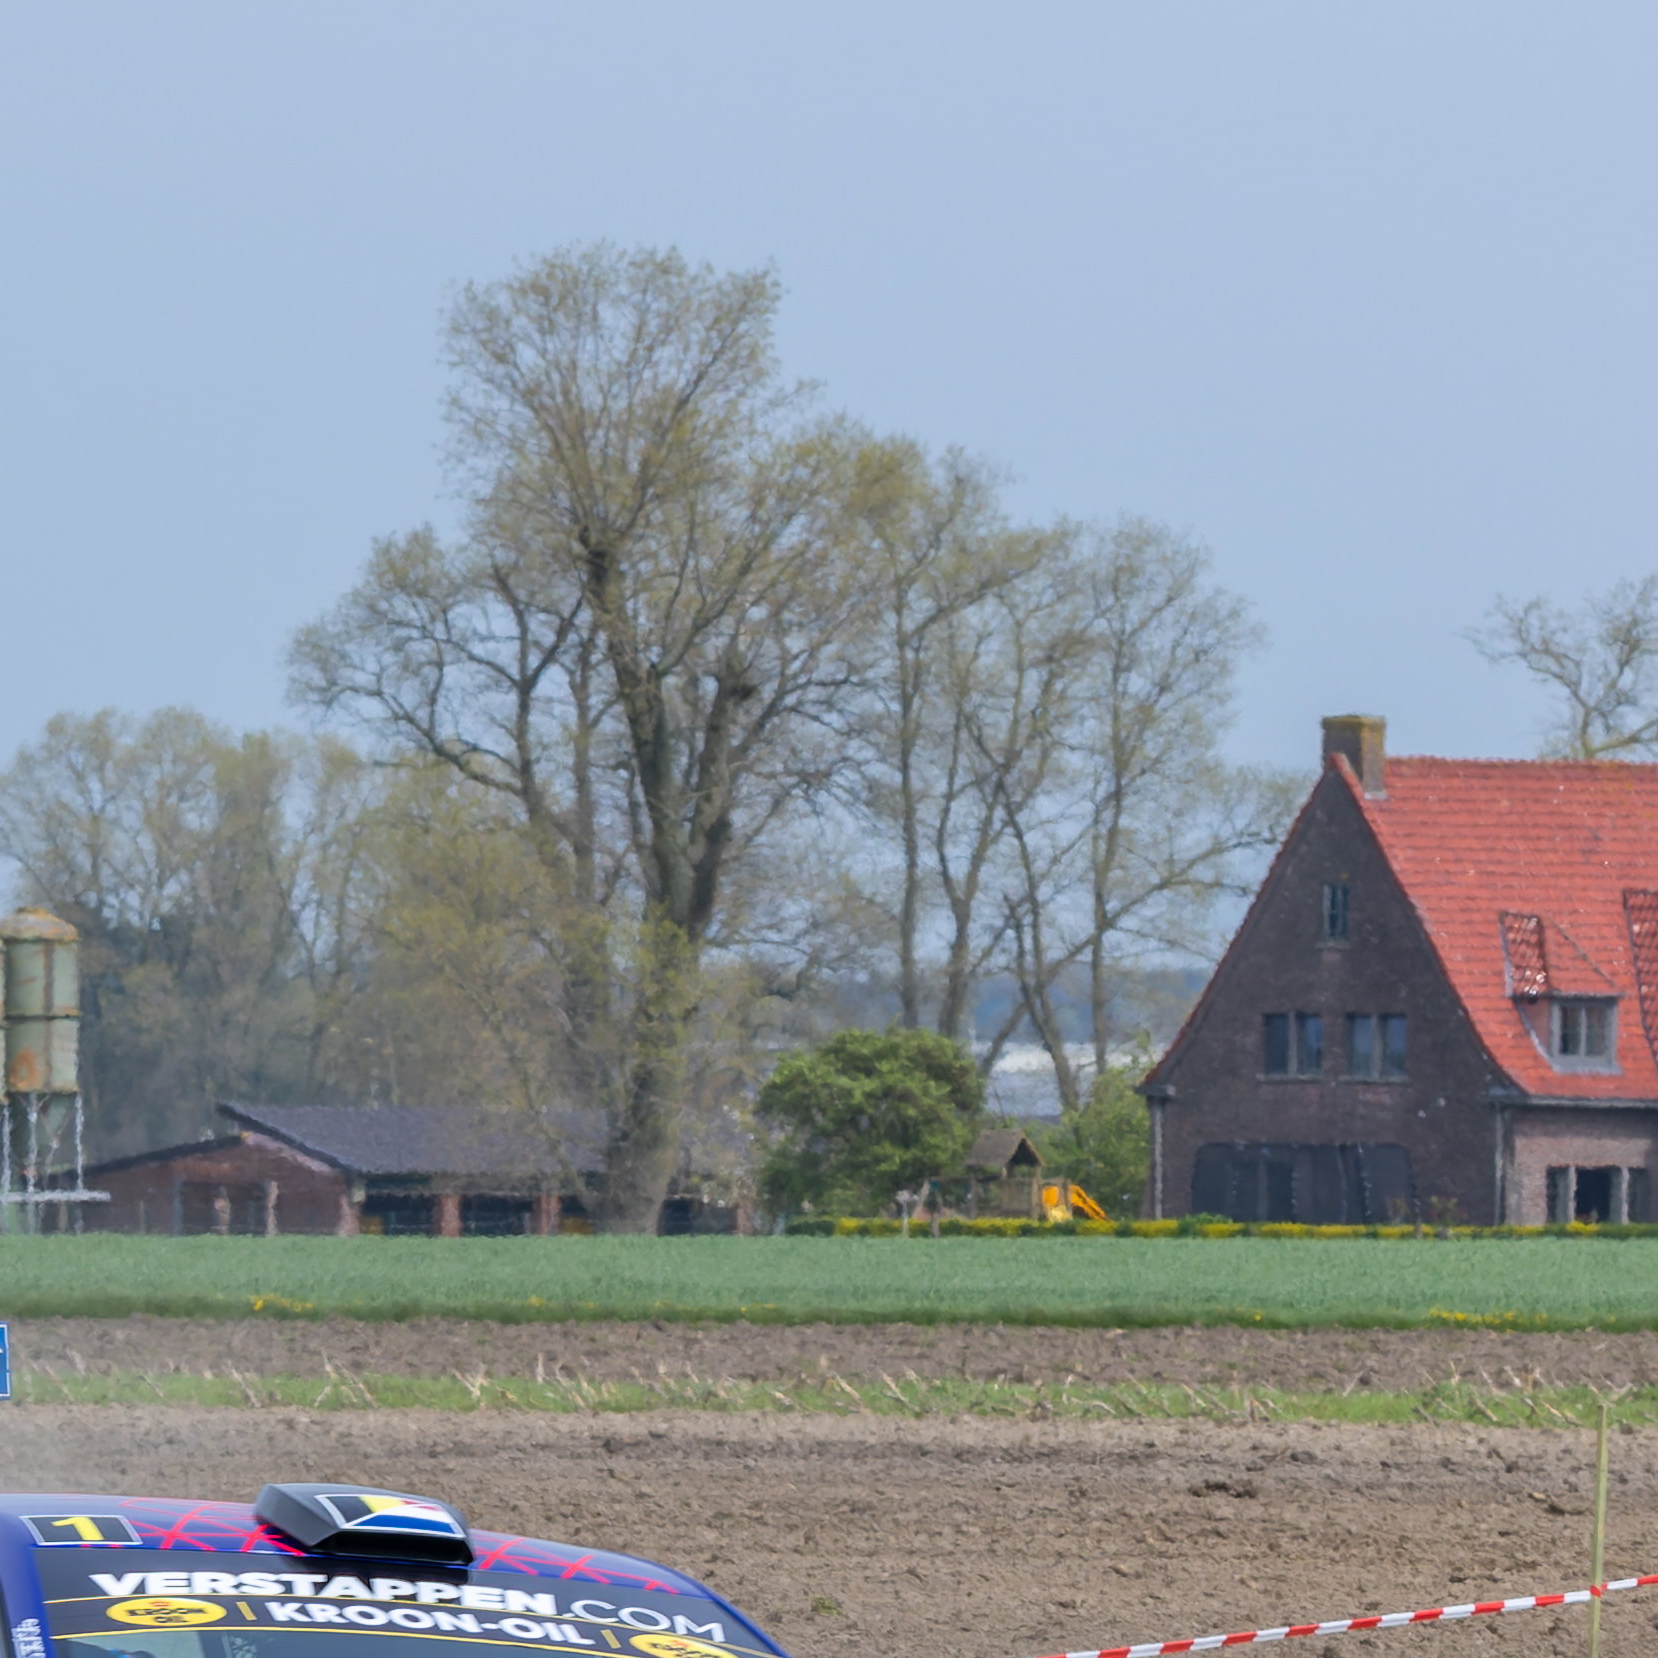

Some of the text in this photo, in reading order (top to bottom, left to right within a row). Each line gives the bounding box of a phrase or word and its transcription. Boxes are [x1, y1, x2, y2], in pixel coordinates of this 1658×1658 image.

[50, 1516, 106, 1541] 1
[88, 1572, 726, 1643] VERSTAPPEN.COM
[263, 1601, 596, 1646] KROON-OIL
